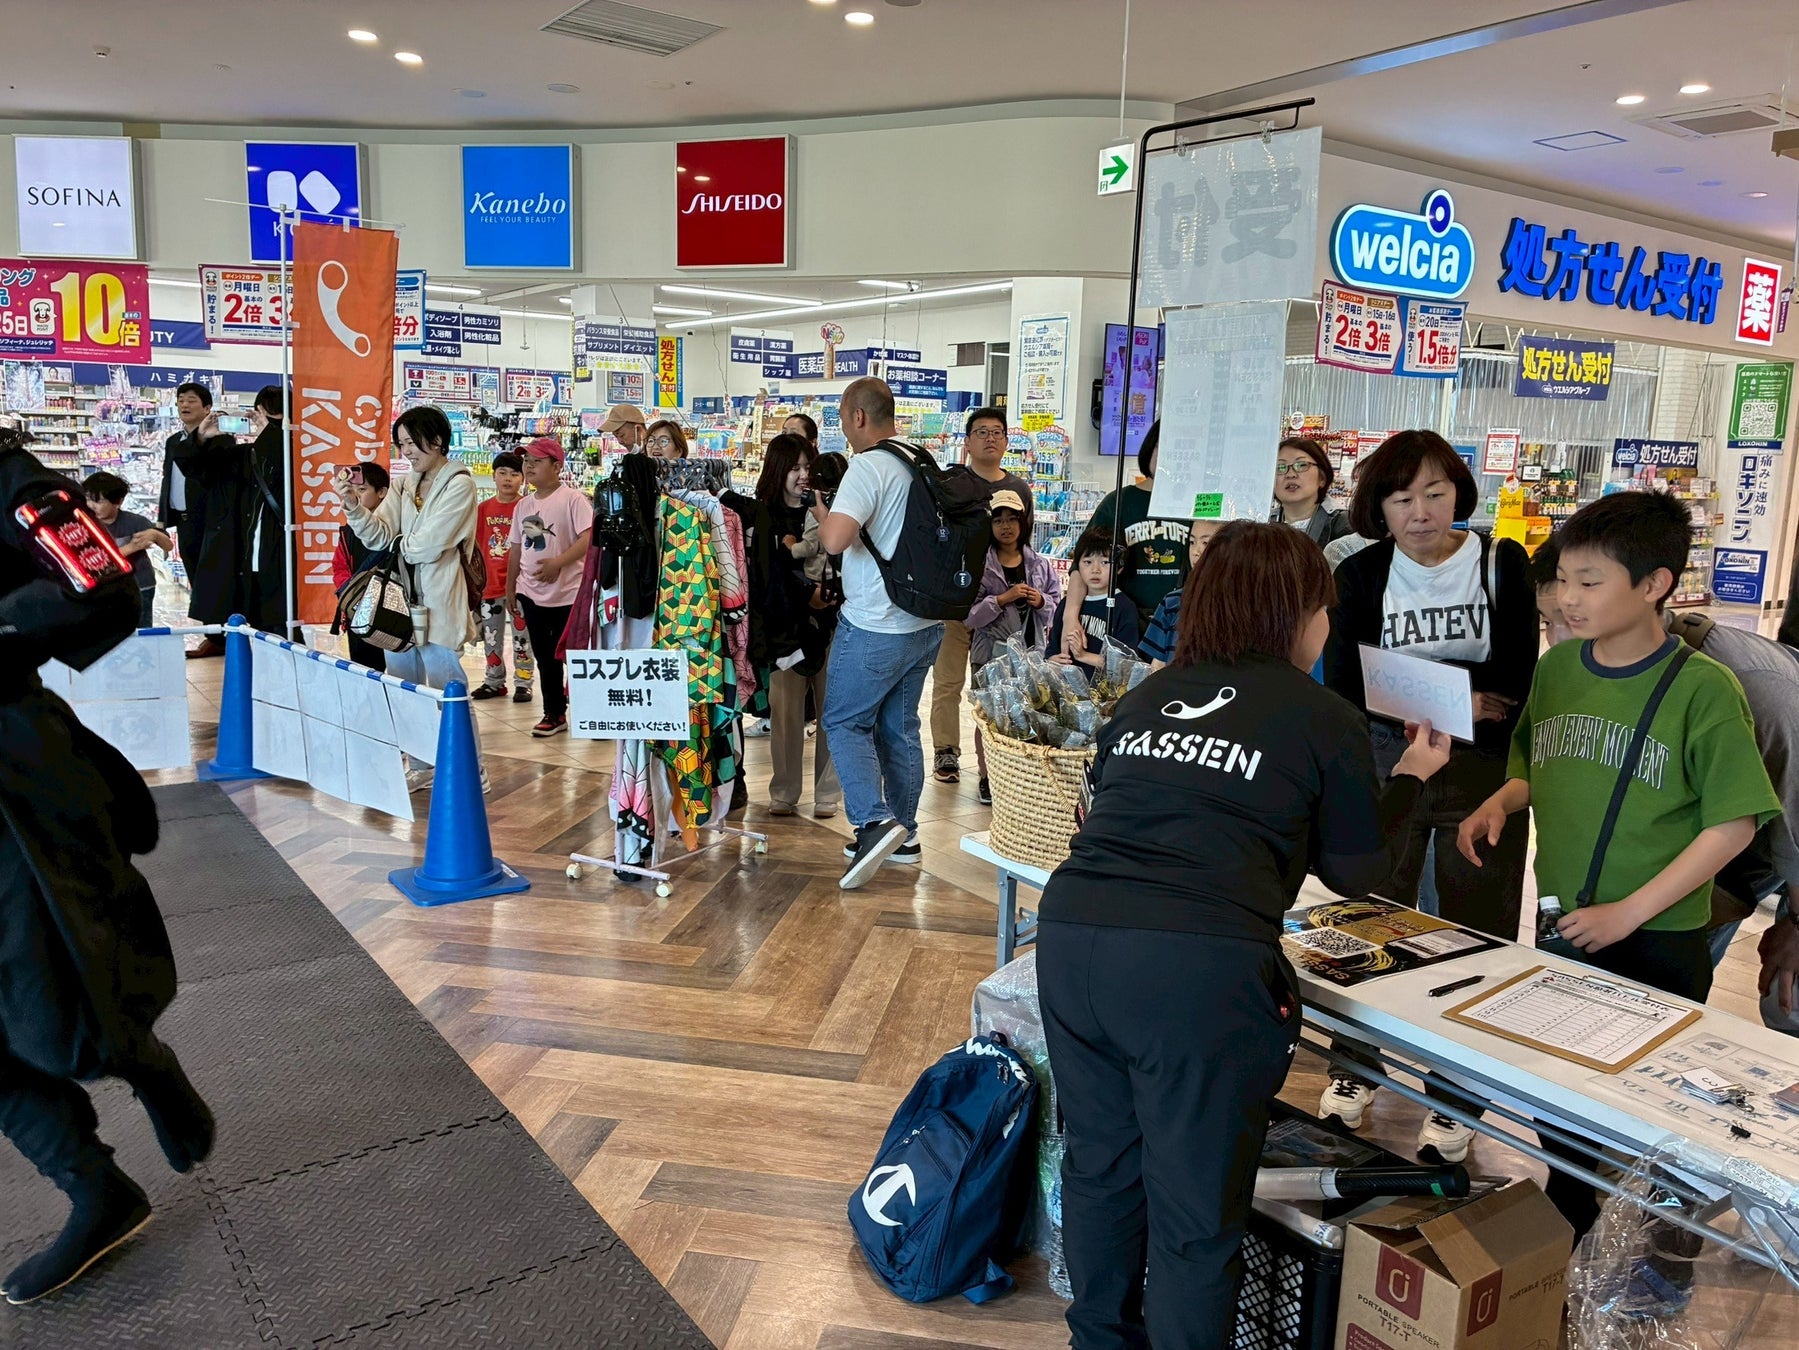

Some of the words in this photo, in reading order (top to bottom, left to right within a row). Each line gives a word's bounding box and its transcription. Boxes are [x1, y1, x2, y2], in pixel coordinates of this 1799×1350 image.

[27, 186, 121, 208] SOFINA
[469, 191, 566, 216] Kanebo
[681, 192, 782, 214] SHISEIDO
[480, 215, 498, 224] FEEL
[525, 216, 556, 224] BEAUTY
[1350, 227, 1460, 283] welcia
[1500, 216, 1726, 325] 処方せん受付
[233, 281, 260, 293] 月曜日
[50, 271, 126, 345] 10
[1344, 302, 1362, 315] 月曜日
[1742, 271, 1775, 333] 薬
[0, 311, 28, 335] 5日
[463, 316, 499, 326] 男性カミソリ
[761, 329, 766, 337] 2
[1425, 316, 1439, 328] 20日
[120, 321, 140, 347] 倍
[429, 328, 452, 339] 入浴剤
[464, 333, 500, 342] 男性化粧品
[587, 342, 620, 351] サプリメント
[623, 344, 655, 353] ダイエット
[660, 339, 675, 383] 処方せん
[1522, 346, 1613, 385] 処方せん受付
[887, 369, 947, 383] お薬相談コーナー
[1640, 443, 1698, 466] 処方せん受付
[300, 386, 342, 586] KASSEN
[1754, 454, 1774, 517] 痛みに速効
[1731, 455, 1758, 543] ロキソニン
[1161, 520, 1190, 546] TUFF
[571, 657, 681, 682] コスプレ衣装
[607, 688, 653, 707] 無料！
[578, 720, 687, 733] ご自由にお使いください！
[1112, 729, 1263, 781] SASSEN
[1357, 1293, 1399, 1323] PORTABLE
[1401, 1321, 1440, 1349] SPEAKER
[1379, 1315, 1412, 1342] T17-T
